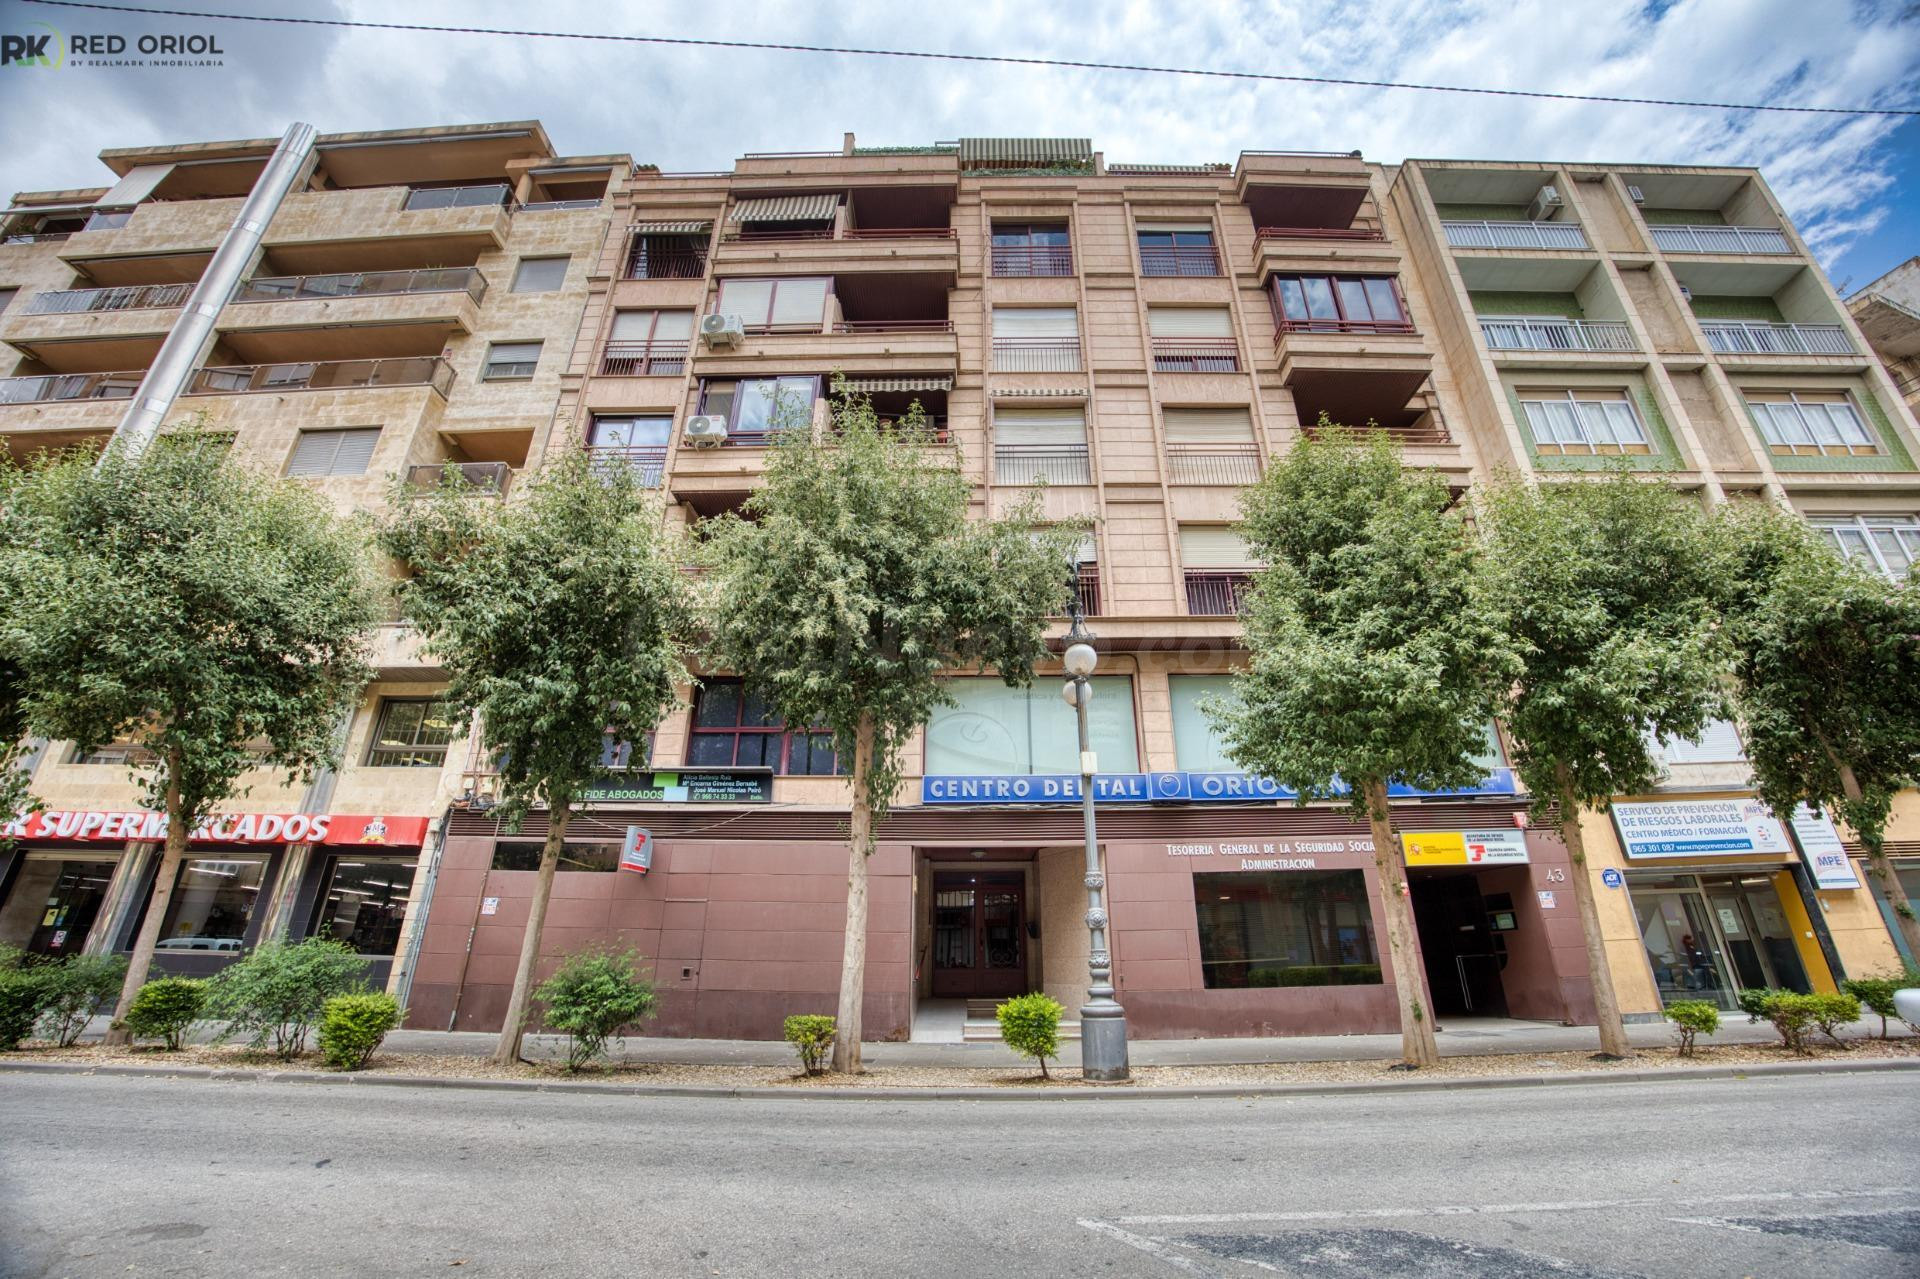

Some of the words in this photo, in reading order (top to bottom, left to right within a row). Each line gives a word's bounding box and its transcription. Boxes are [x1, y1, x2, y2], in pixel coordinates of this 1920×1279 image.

[583, 790, 606, 799] FIDE
[606, 790, 664, 799] ABOGADOS
[930, 779, 1031, 797] CENTRO
[1617, 806, 1660, 817] SERVICIO
[1663, 805, 1677, 815] DE
[1678, 803, 1738, 814] PREVENCIÓN
[1622, 817, 1637, 828] DE
[1639, 815, 1683, 826] RIESGOS
[1683, 813, 1743, 825] LABORALES
[1626, 829, 1660, 839] CENTRO
[1661, 826, 1694, 837] MÉDICO
[1699, 825, 1748, 836] FORMACIÓN
[1219, 843, 1260, 855] GENERAL
[1263, 843, 1274, 854] DE
[1279, 843, 1291, 854] LA
[1294, 841, 1345, 853] SEGURIDAD
[1348, 840, 1376, 852] SOCIA
[1632, 844, 1647, 853] 965
[1648, 843, 1660, 852] 301
[1661, 843, 1675, 852] 087
[1241, 858, 1316, 870] ADMINISTRACION
[1817, 855, 1843, 867] MPE
[1546, 868, 1565, 882] 43
